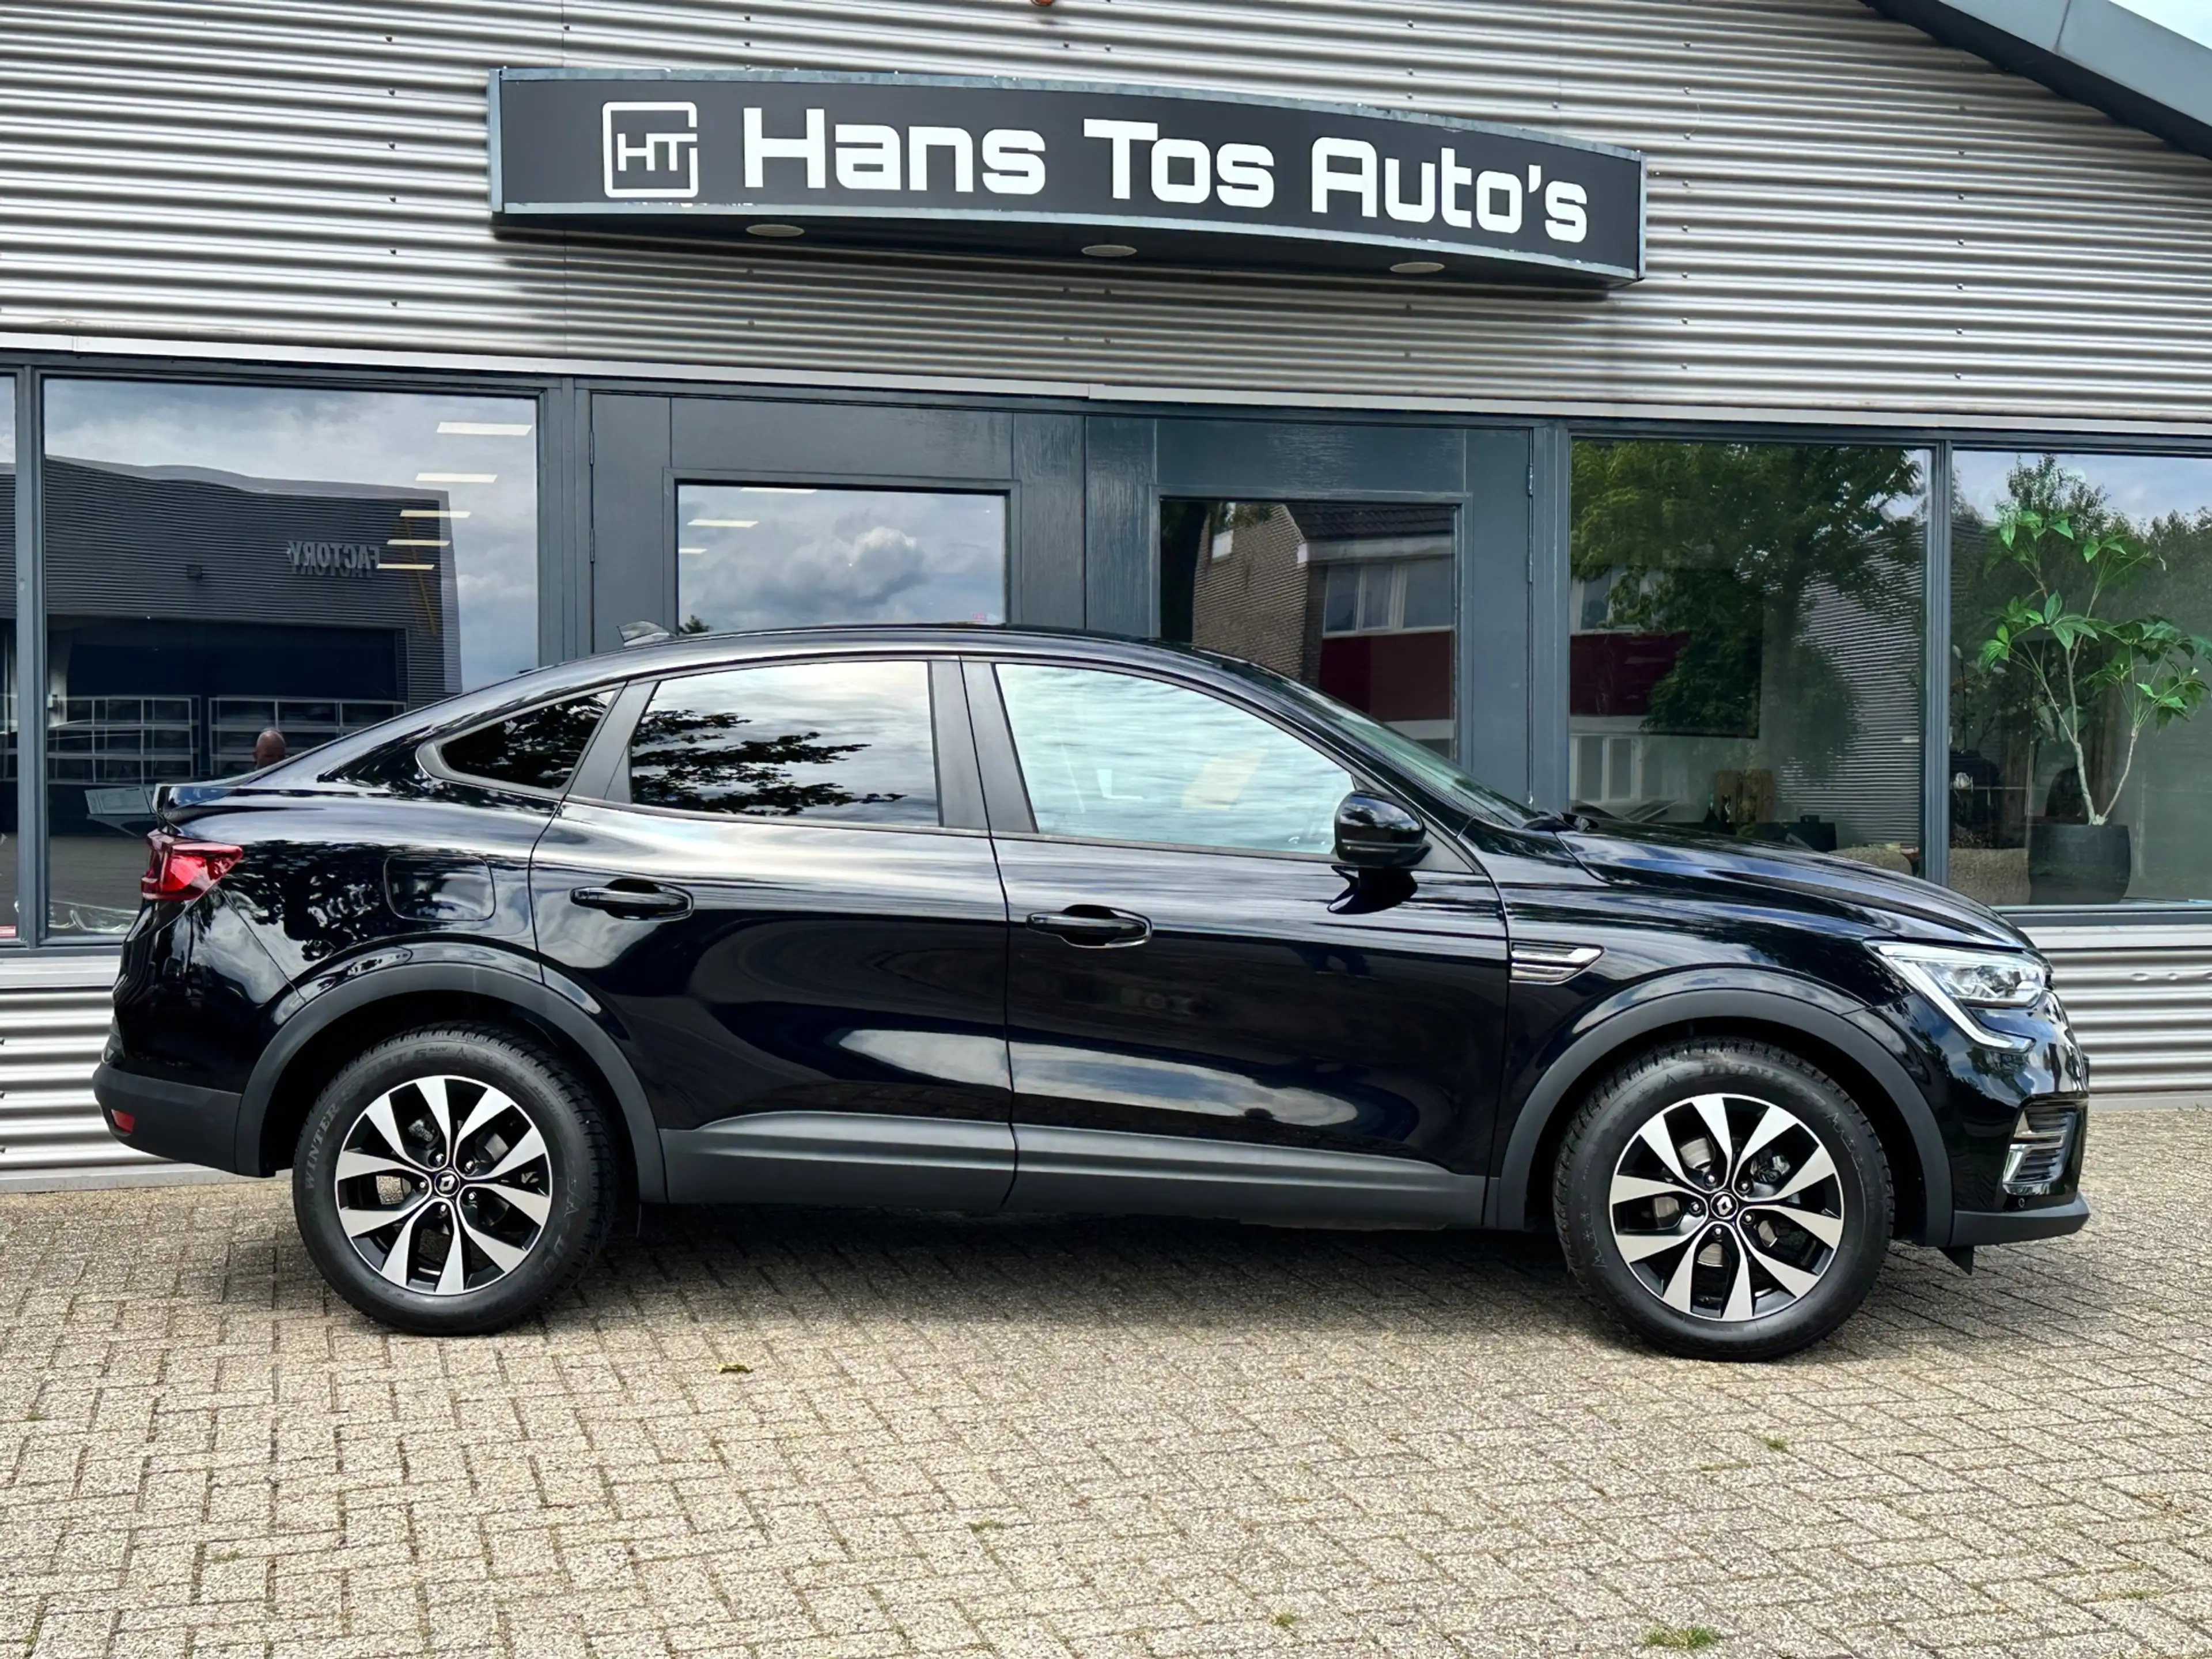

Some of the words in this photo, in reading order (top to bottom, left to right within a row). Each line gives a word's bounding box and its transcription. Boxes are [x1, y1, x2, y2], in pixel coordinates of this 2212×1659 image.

[617, 133, 698, 171] HT
[744, 108, 1046, 195] Hans
[1084, 119, 1274, 208] Tos
[1312, 137, 1588, 243] Auto's
[305, 1103, 340, 1190] WINTER
